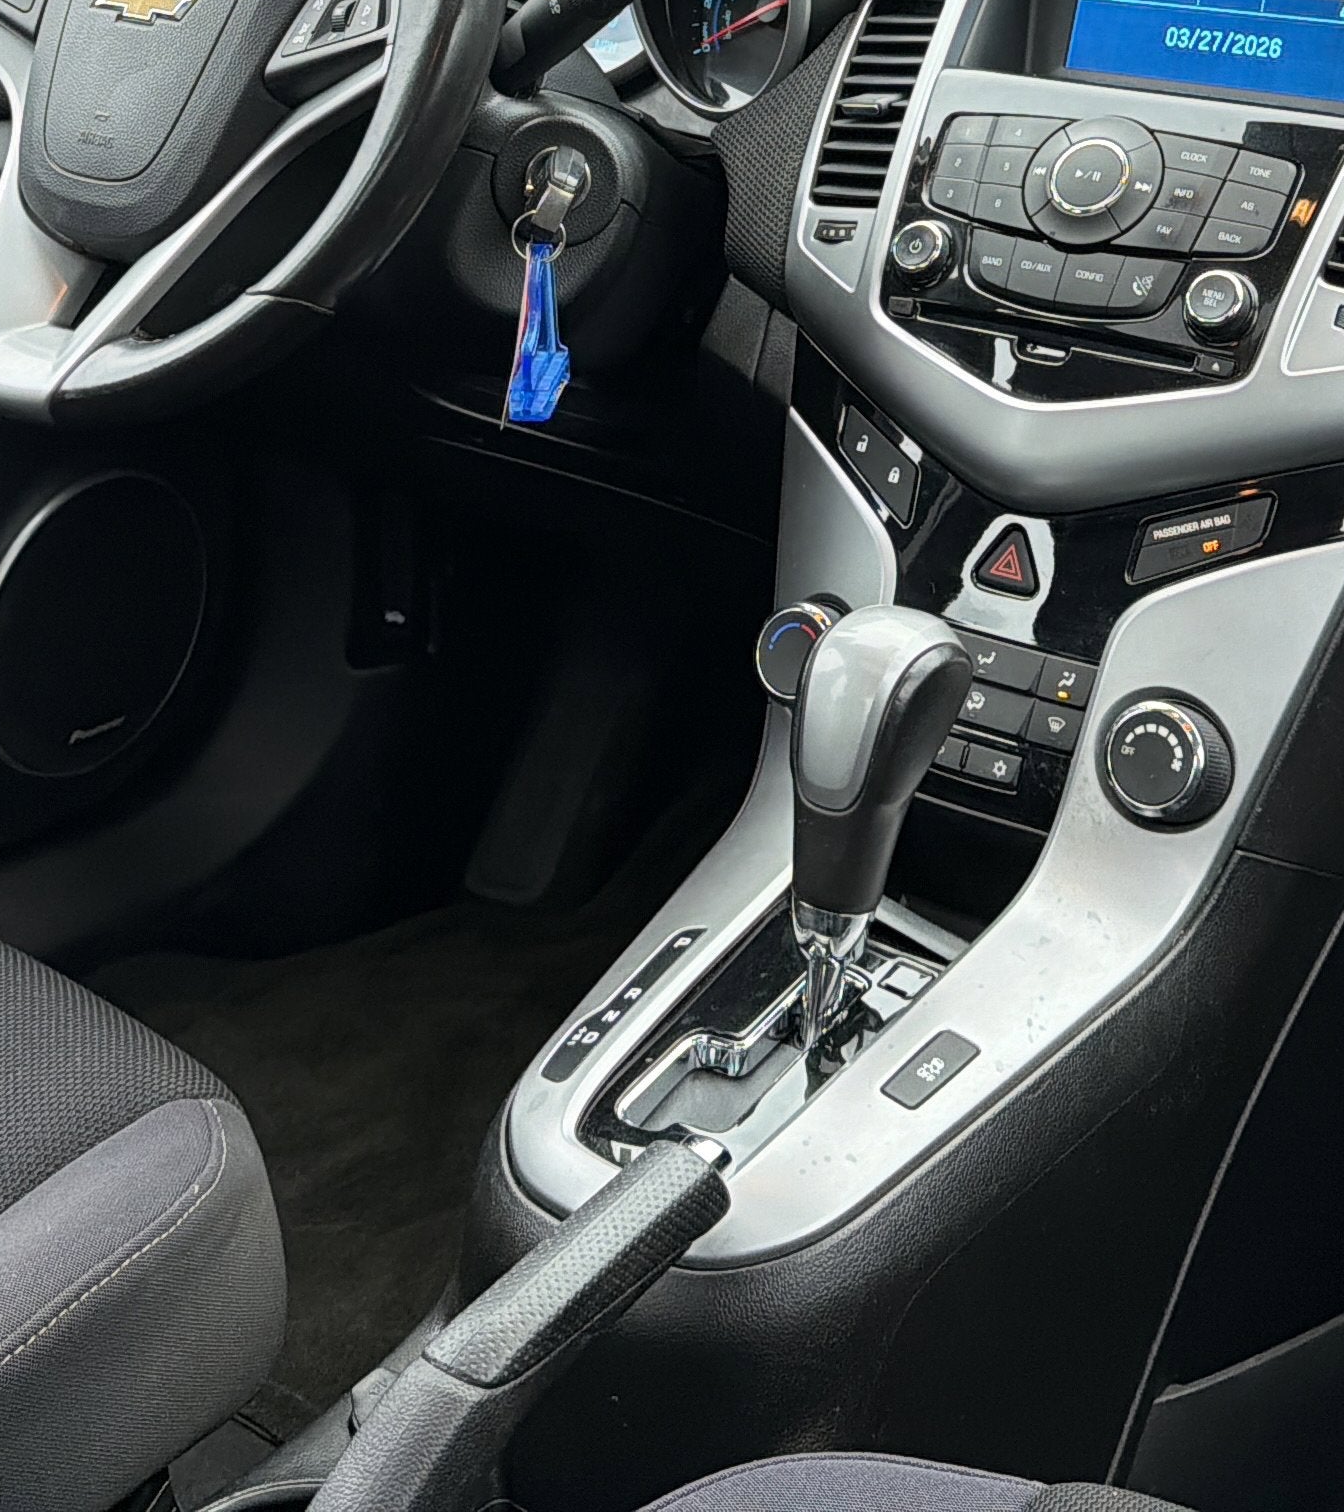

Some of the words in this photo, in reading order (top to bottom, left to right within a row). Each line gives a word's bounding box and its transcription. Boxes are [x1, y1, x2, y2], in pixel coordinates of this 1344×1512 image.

[1164, 26, 1283, 59] 03/27/2026
[954, 158, 961, 168] 2
[1181, 151, 1208, 163] CLOCK
[1249, 167, 1272, 178] TONE
[1173, 188, 1194, 198] INFO
[1157, 225, 1174, 235] FAV
[1218, 232, 1242, 244] BACK
[982, 255, 1003, 267] BAND
[1021, 259, 1052, 273] CD/AUX
[1075, 270, 1105, 283] CONFIG
[1202, 288, 1225, 300] MENU
[1152, 522, 1199, 540] PASSENGER
[1200, 518, 1213, 530] AIR
[1214, 514, 1231, 527] BAG
[1202, 540, 1219, 552] OFF
[1120, 745, 1136, 755] OFF
[673, 937, 692, 949] P
[624, 987, 642, 1000] R
[601, 1010, 621, 1023] N
[581, 1031, 600, 1044] D
